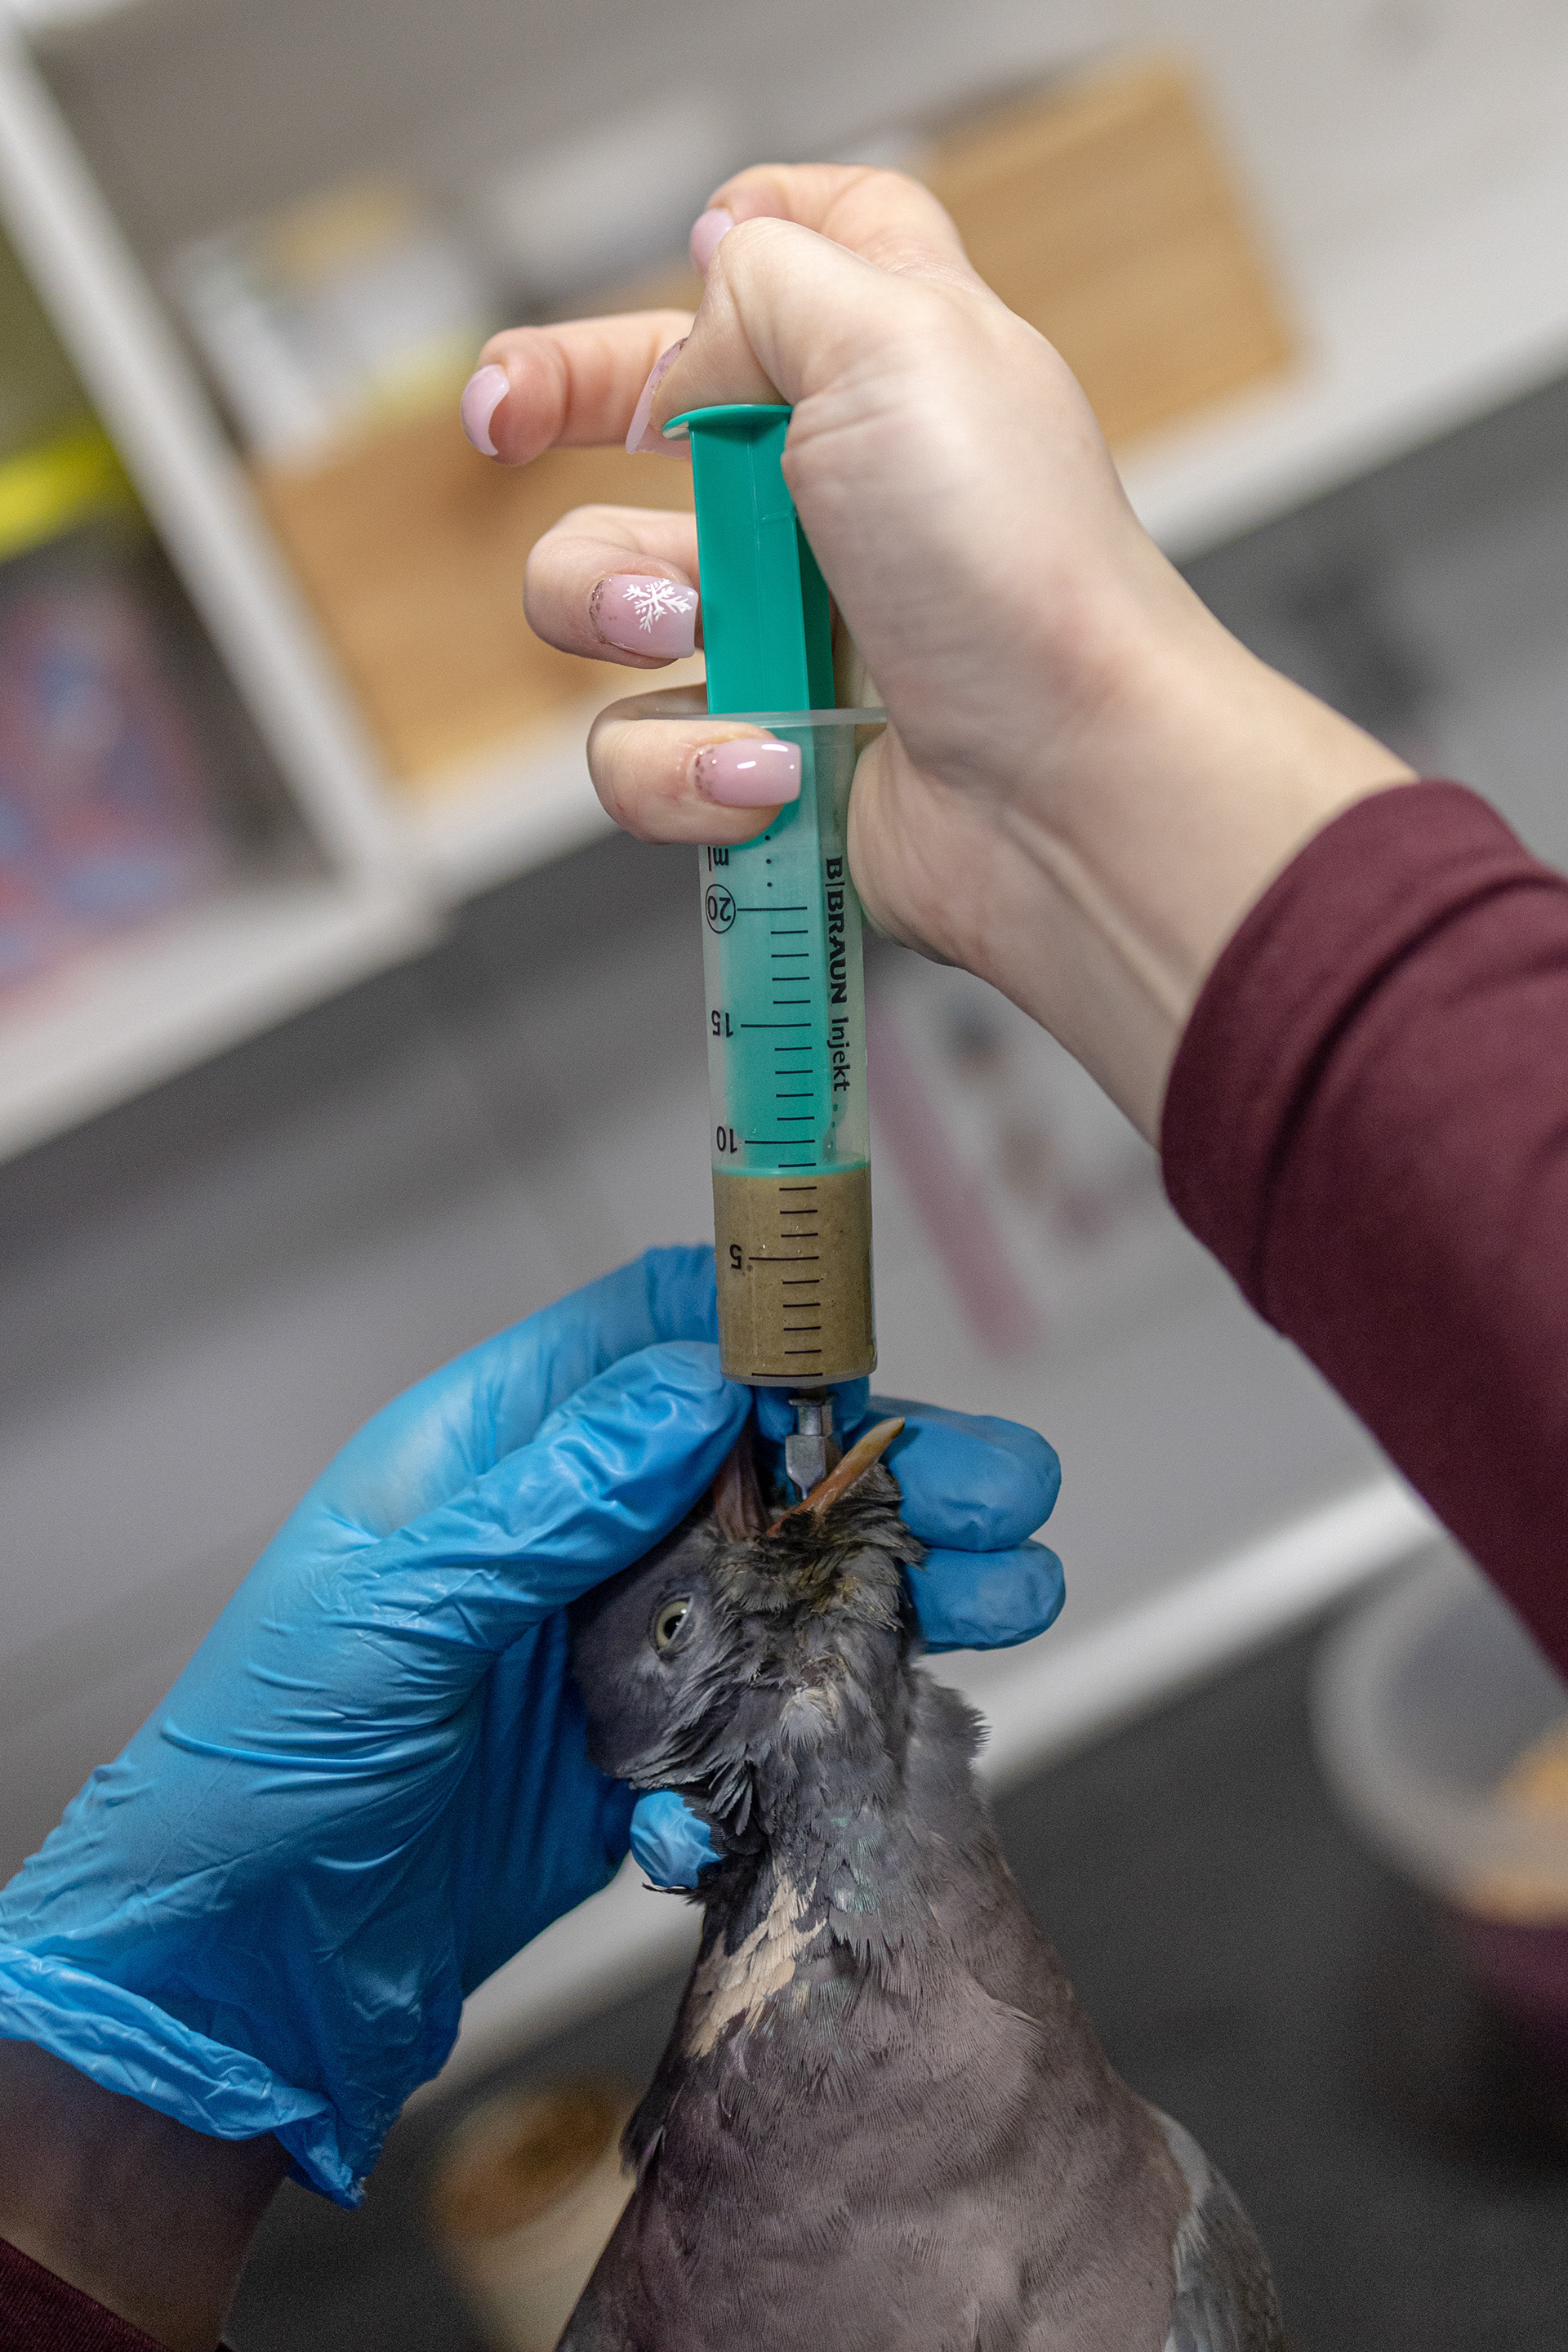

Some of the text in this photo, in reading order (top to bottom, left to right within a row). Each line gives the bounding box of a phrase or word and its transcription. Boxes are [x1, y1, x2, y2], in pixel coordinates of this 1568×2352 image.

[707, 845, 729, 871] ml
[707, 895, 732, 921] 20
[711, 1009, 734, 1038] 15
[826, 1017, 850, 1092] Injekt
[716, 1125, 738, 1155] 10
[729, 1243, 742, 1270] 5
